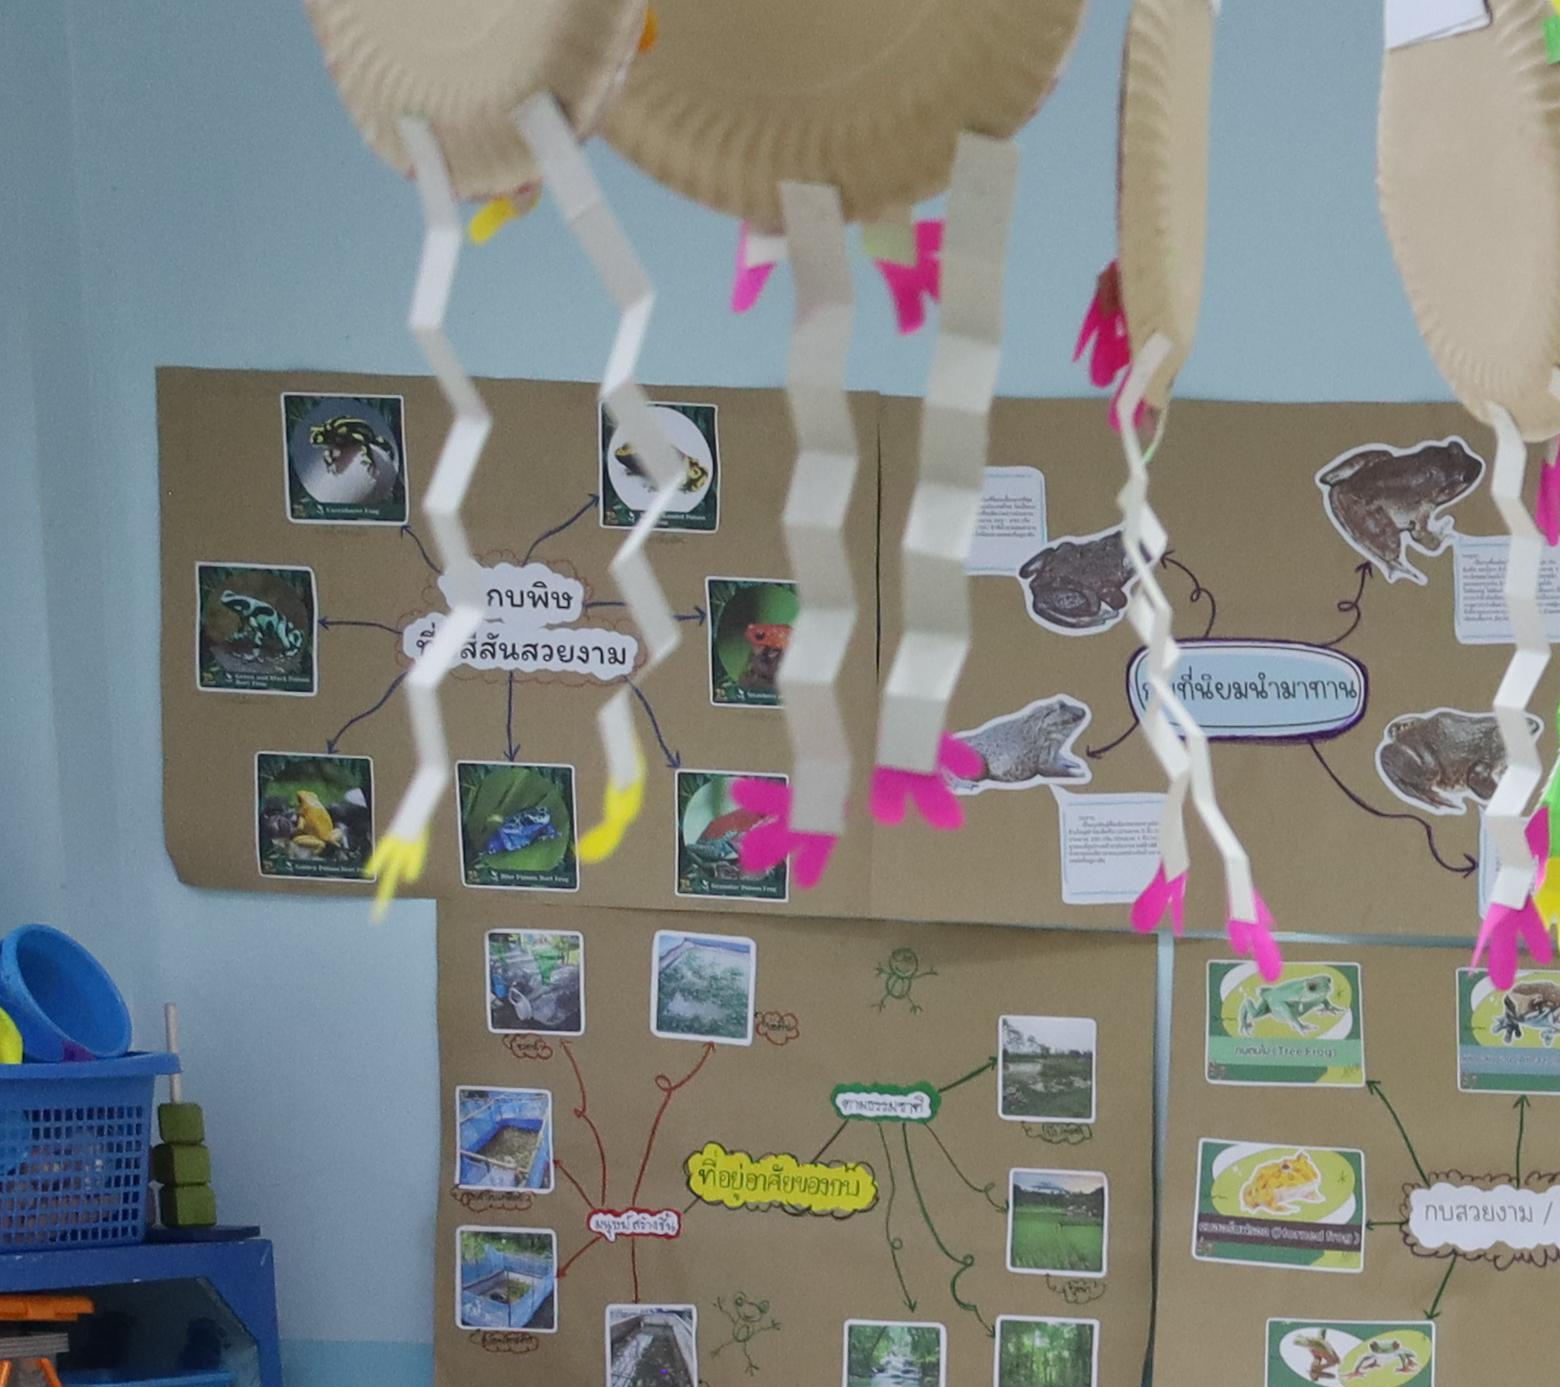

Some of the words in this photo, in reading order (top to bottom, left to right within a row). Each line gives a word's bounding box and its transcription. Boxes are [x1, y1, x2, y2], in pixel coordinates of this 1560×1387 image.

[417, 632, 628, 667] ที่สีสันสวยงาม
[1143, 669, 1358, 702] กที่นิยมนำมาทาน
